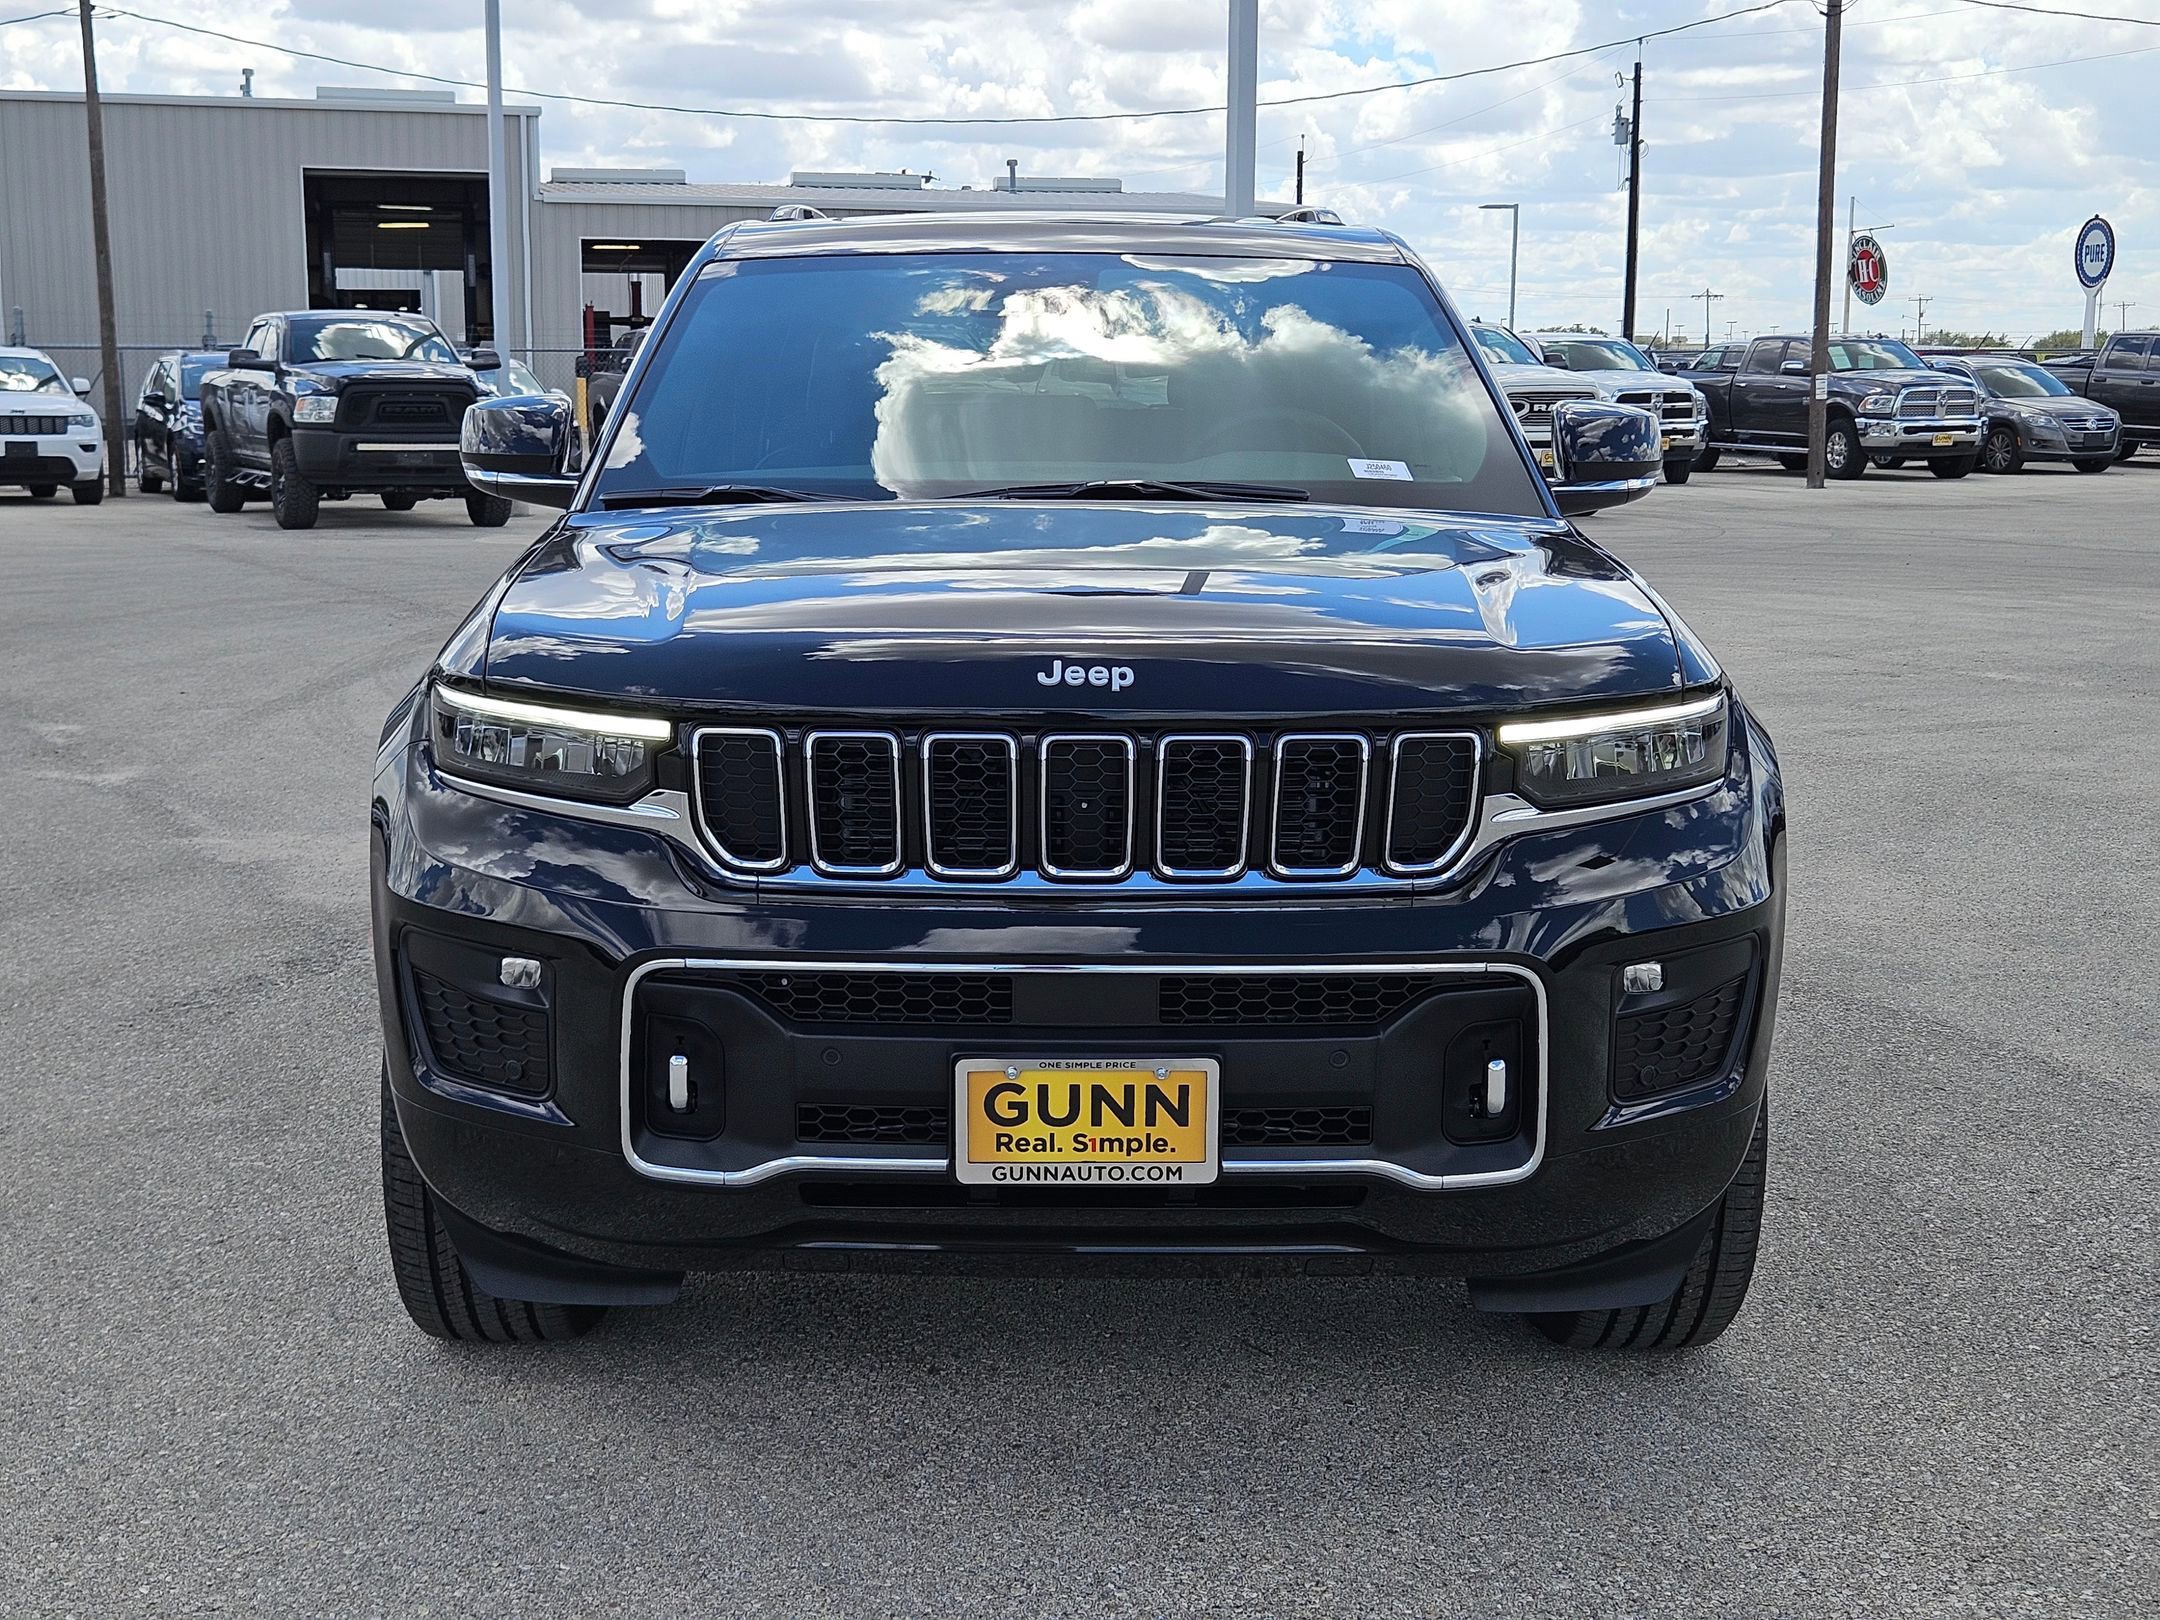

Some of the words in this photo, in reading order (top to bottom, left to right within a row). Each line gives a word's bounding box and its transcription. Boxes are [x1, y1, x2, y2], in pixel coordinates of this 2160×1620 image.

[2084, 243, 2106, 263] PURE
[1037, 660, 1135, 691] Jeep
[1038, 1061, 1062, 1069] ONE
[1065, 1061, 1102, 1069] SIMPLE
[1105, 1061, 1137, 1069] PRICE
[983, 1082, 1190, 1128] GUNN
[995, 1133, 1063, 1153] Real.
[991, 1165, 1183, 1182] GUNNAUTO.COM
